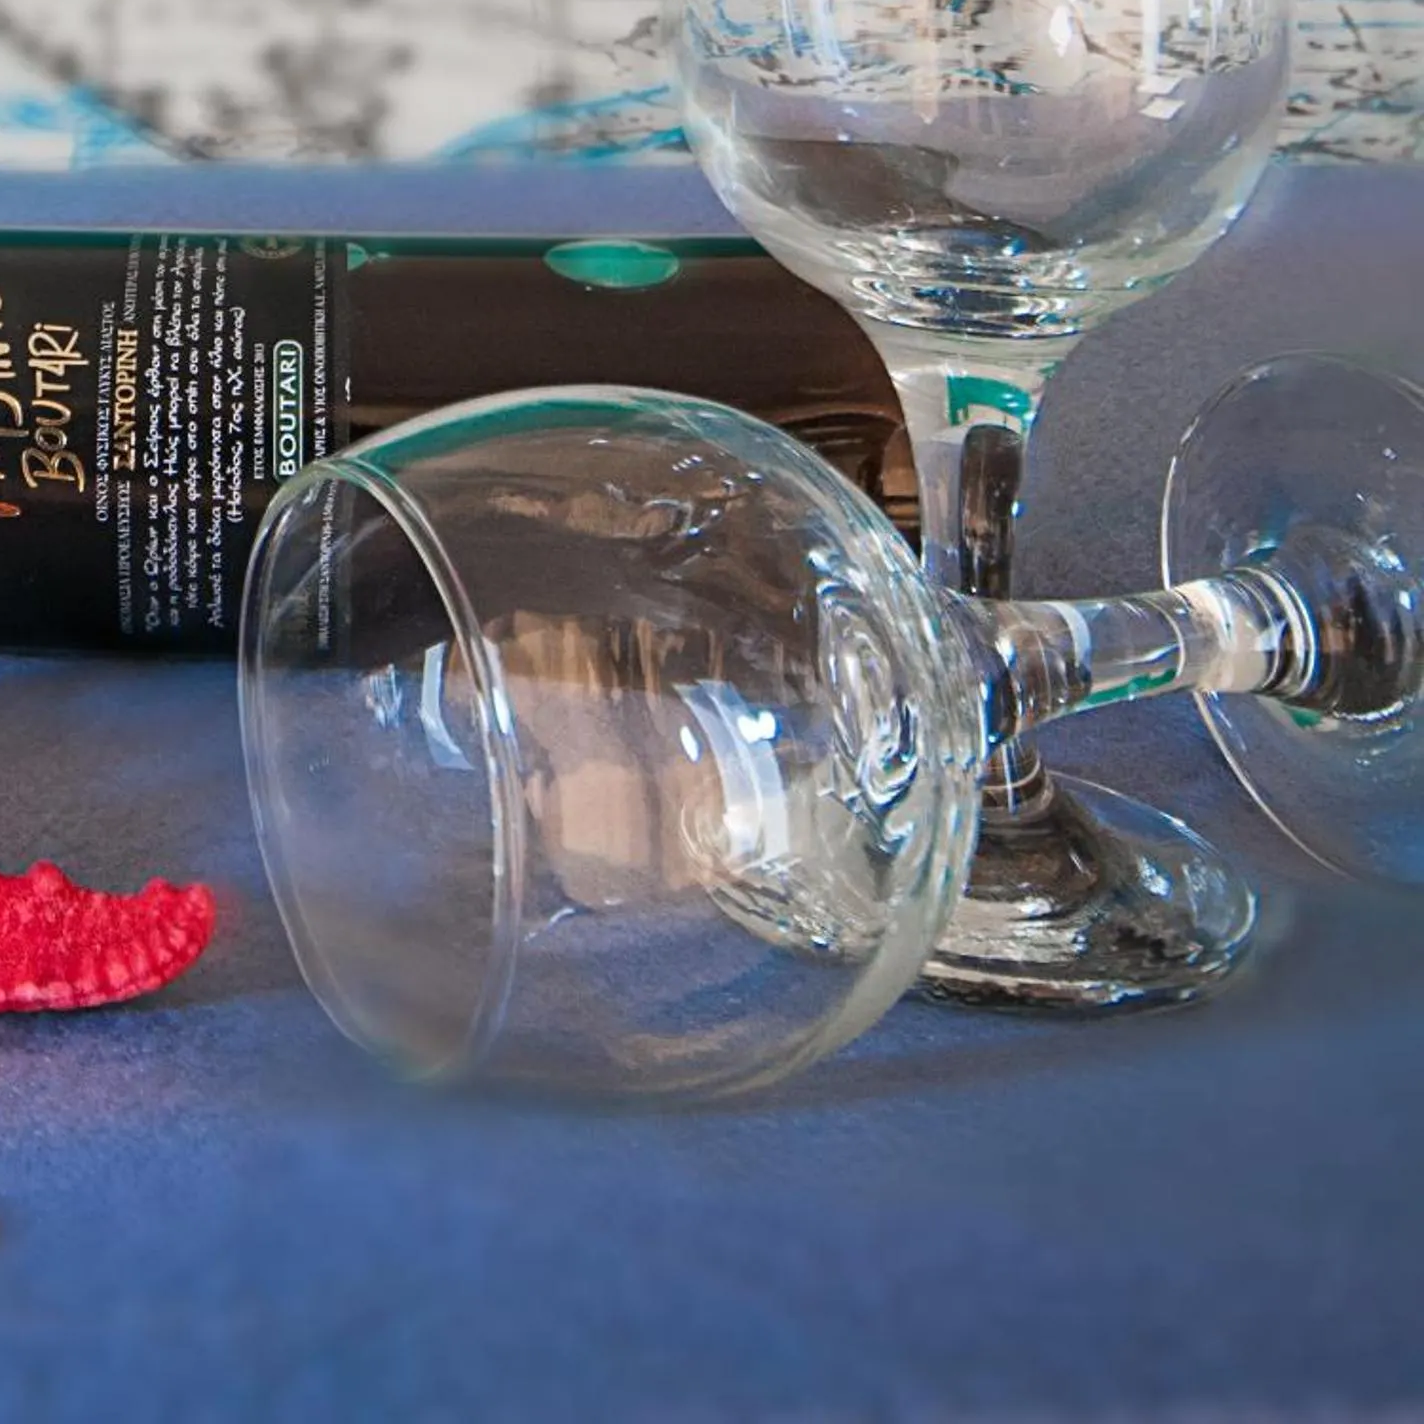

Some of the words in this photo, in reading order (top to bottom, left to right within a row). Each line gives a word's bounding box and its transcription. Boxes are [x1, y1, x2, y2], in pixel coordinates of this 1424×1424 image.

[170, 352, 180, 370] να
[113, 328, 138, 470] ΣΑΝΤΟΡΙΝΗ
[166, 376, 182, 429] μπορεί
[212, 374, 222, 410] στον
[228, 402, 244, 434] 7ος
[279, 350, 297, 476] BOUTARI
[314, 416, 326, 426] &
[96, 408, 109, 470] ΦΥΣΙΚΩΣ
[144, 404, 163, 468] Σείριος
[187, 420, 197, 451] στο
[149, 474, 158, 487] ο
[184, 456, 202, 502] φέρε
[254, 447, 264, 480] ΕΤΟΣ
[96, 474, 108, 521] ΟΙΝΟΣ
[148, 494, 158, 520] και
[188, 508, 197, 533] και
[206, 506, 222, 546] δέκα
[212, 552, 222, 568] τα
